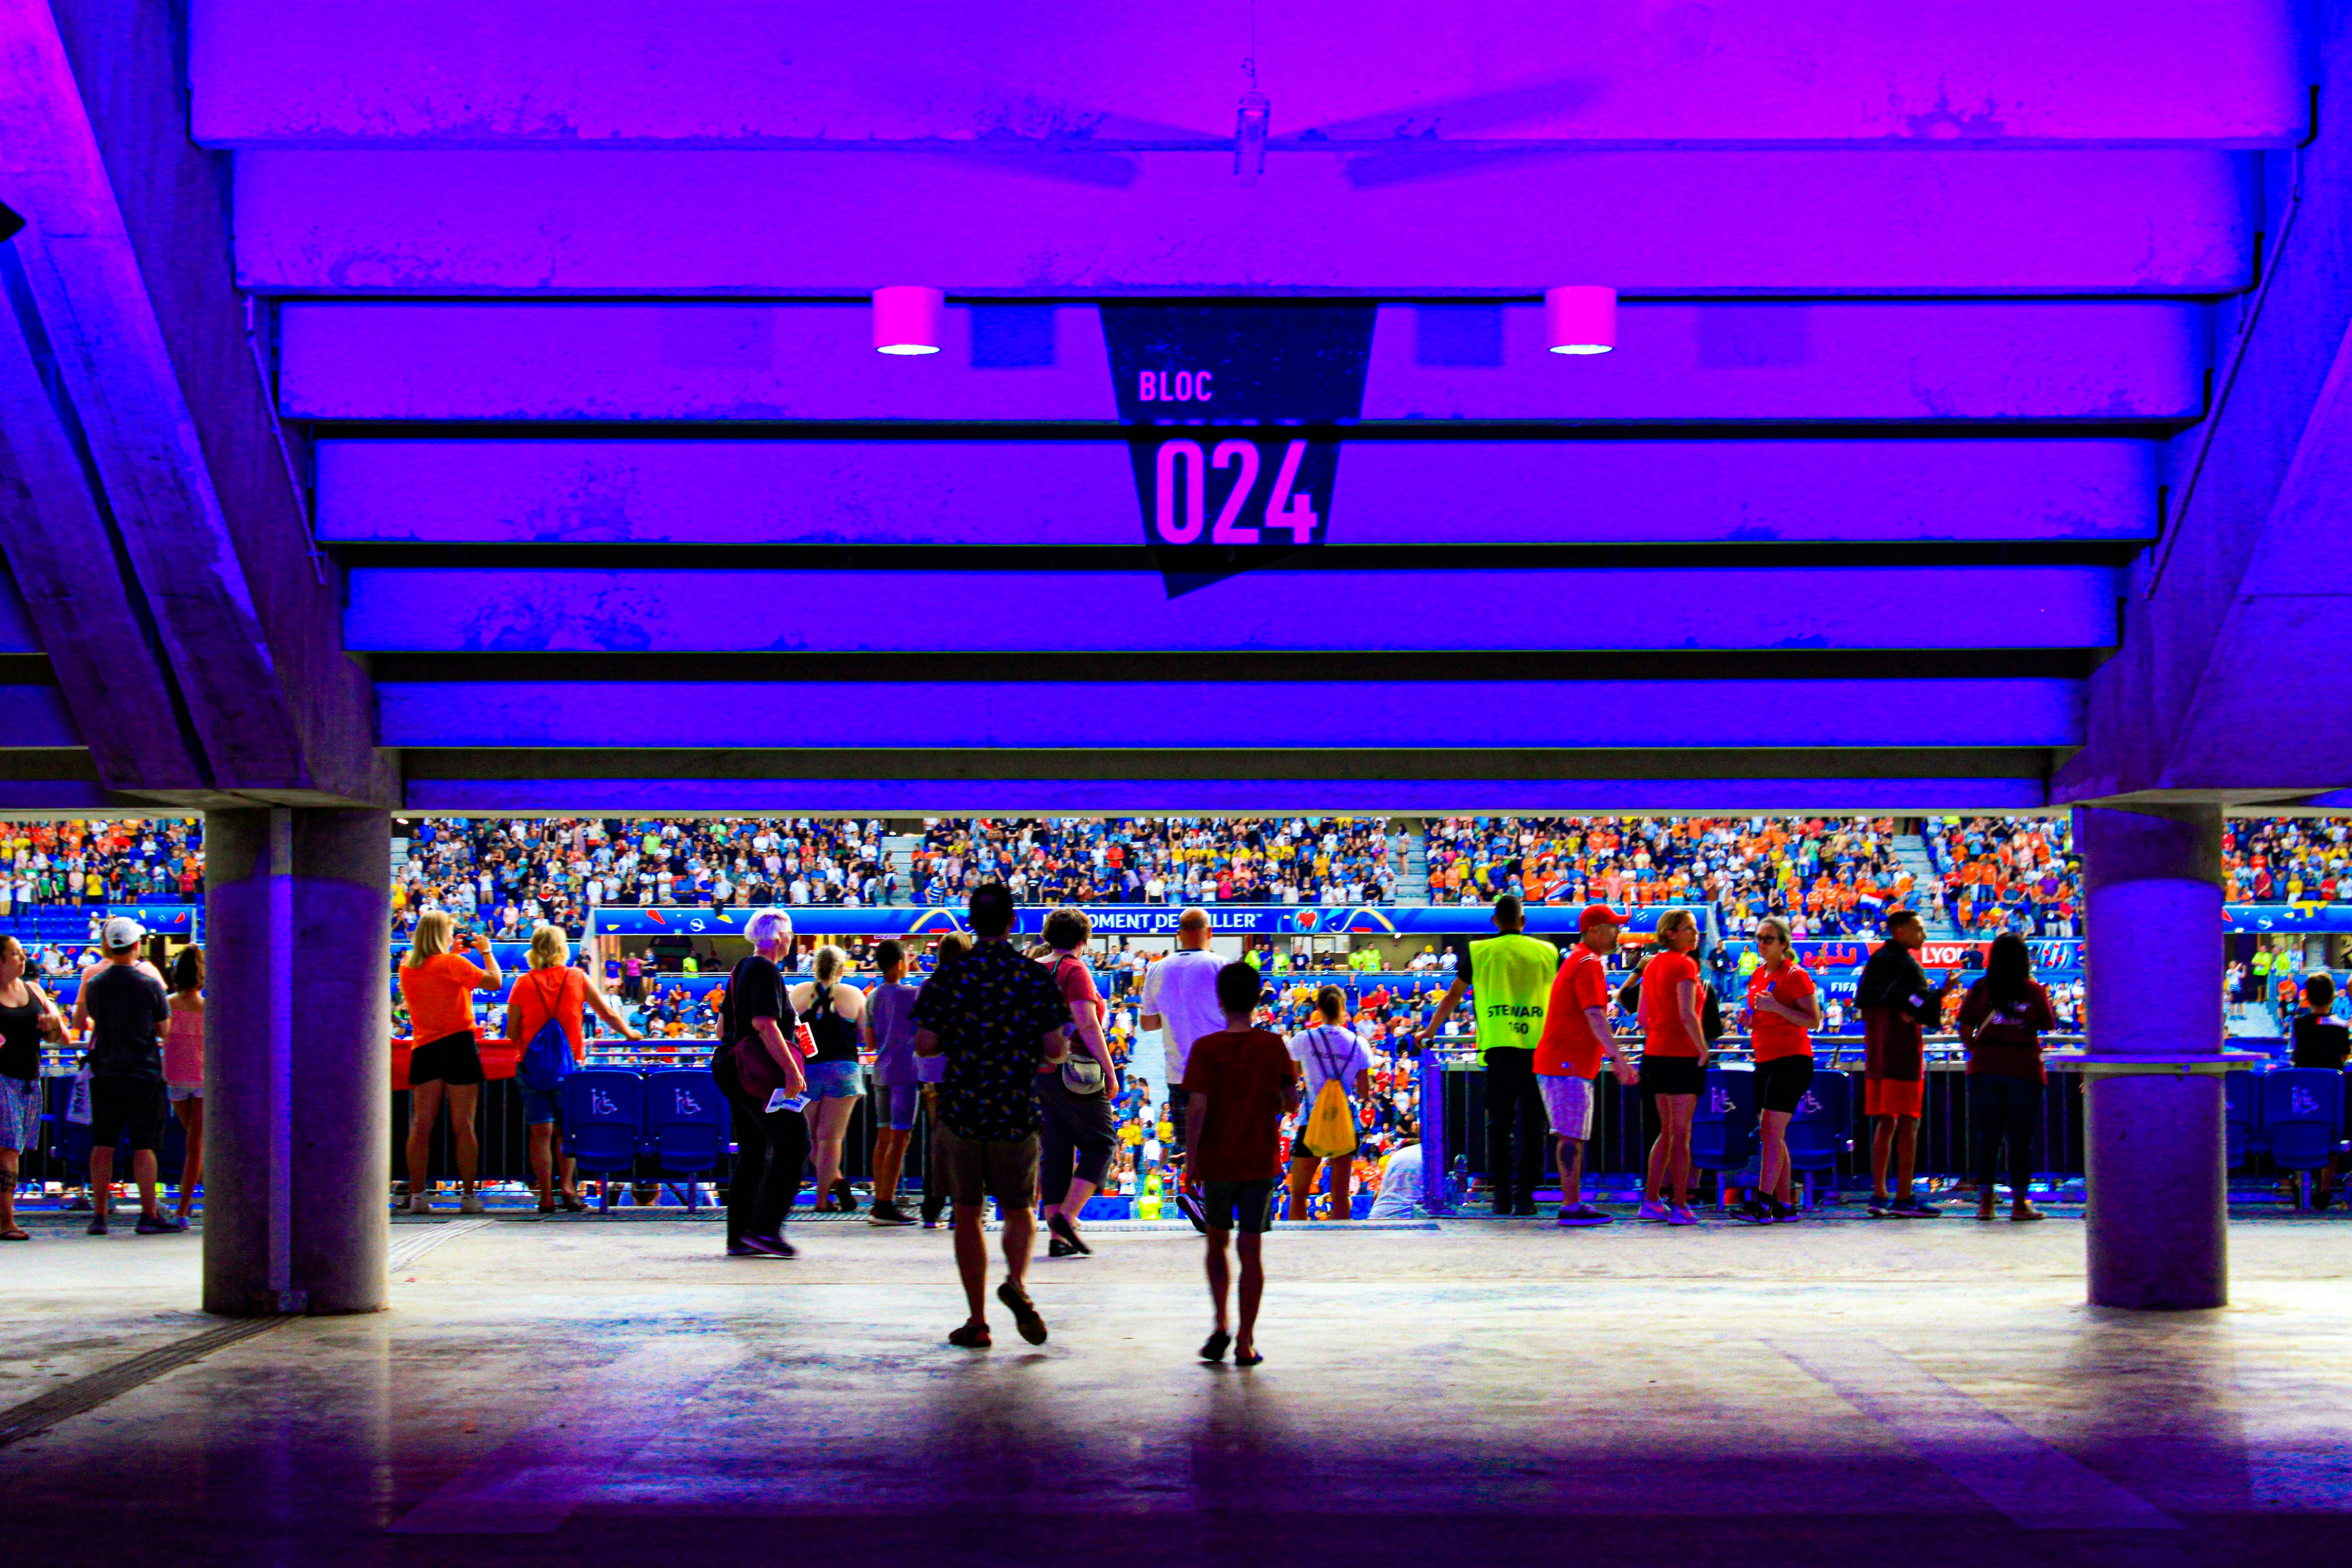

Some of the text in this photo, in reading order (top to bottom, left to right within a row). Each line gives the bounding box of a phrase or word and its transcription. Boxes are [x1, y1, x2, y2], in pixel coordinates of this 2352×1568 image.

[1139, 371, 1213, 401] BLOC
[1156, 439, 1319, 544] 024
[1088, 914, 1151, 929] OMENT
[1155, 914, 1180, 928] DE
[1830, 982, 1857, 992] FIFA
